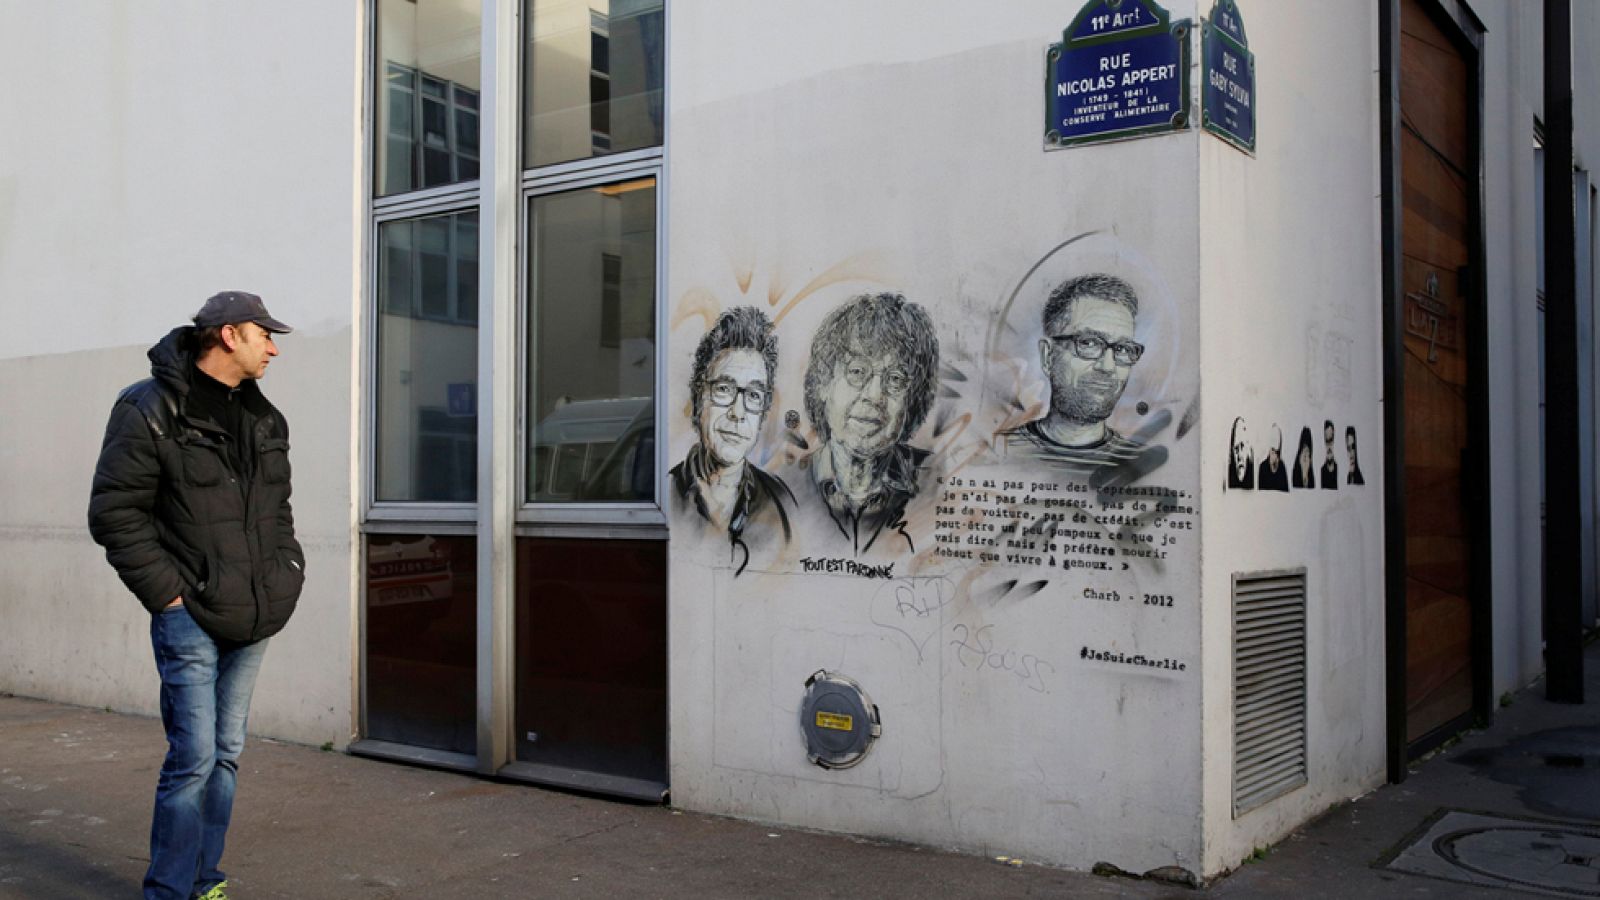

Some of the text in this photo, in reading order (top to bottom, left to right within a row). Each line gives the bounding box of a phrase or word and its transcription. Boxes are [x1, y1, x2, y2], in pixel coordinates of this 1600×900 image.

[1099, 53, 1131, 71] RUE
[1057, 64, 1177, 97] NICOLAS APPERT
[1062, 102, 1170, 127] CONSERVE ALIMENTAIRE
[1073, 95, 1158, 115] INVENTEUR DE LA
[950, 476, 963, 486] Je
[1003, 480, 1024, 491] pas
[1031, 481, 1059, 492] peur
[1066, 482, 1088, 493] des
[943, 490, 956, 502] je
[962, 491, 988, 502] n'ai
[995, 494, 1016, 506] pas
[1023, 494, 1037, 505] de
[1102, 501, 1124, 511] pas
[1132, 501, 1147, 511] de
[936, 505, 955, 516] pas
[961, 506, 975, 516] de
[1043, 512, 1065, 522] pas
[1072, 513, 1087, 524] de
[1154, 517, 1193, 530] C'est
[935, 532, 960, 543] vais
[1006, 539, 1035, 550] mais
[1043, 539, 1057, 553] je
[1122, 548, 1167, 559] mourir
[1001, 524, 1015, 533] un
[1022, 526, 1043, 536] peu
[1050, 527, 1101, 539] pompeux
[1108, 532, 1123, 541] ce
[1131, 533, 1154, 544] que
[1161, 533, 1176, 546] je
[800, 556, 826, 573] TOUT
[826, 558, 845, 573] EST
[934, 546, 973, 559] debout
[980, 551, 1000, 562] que
[1006, 553, 1042, 565] vivre
[1083, 587, 1120, 602] Charb
[1143, 593, 1173, 607] 2012
[1080, 646, 1186, 671] #JeSuisCharlie
